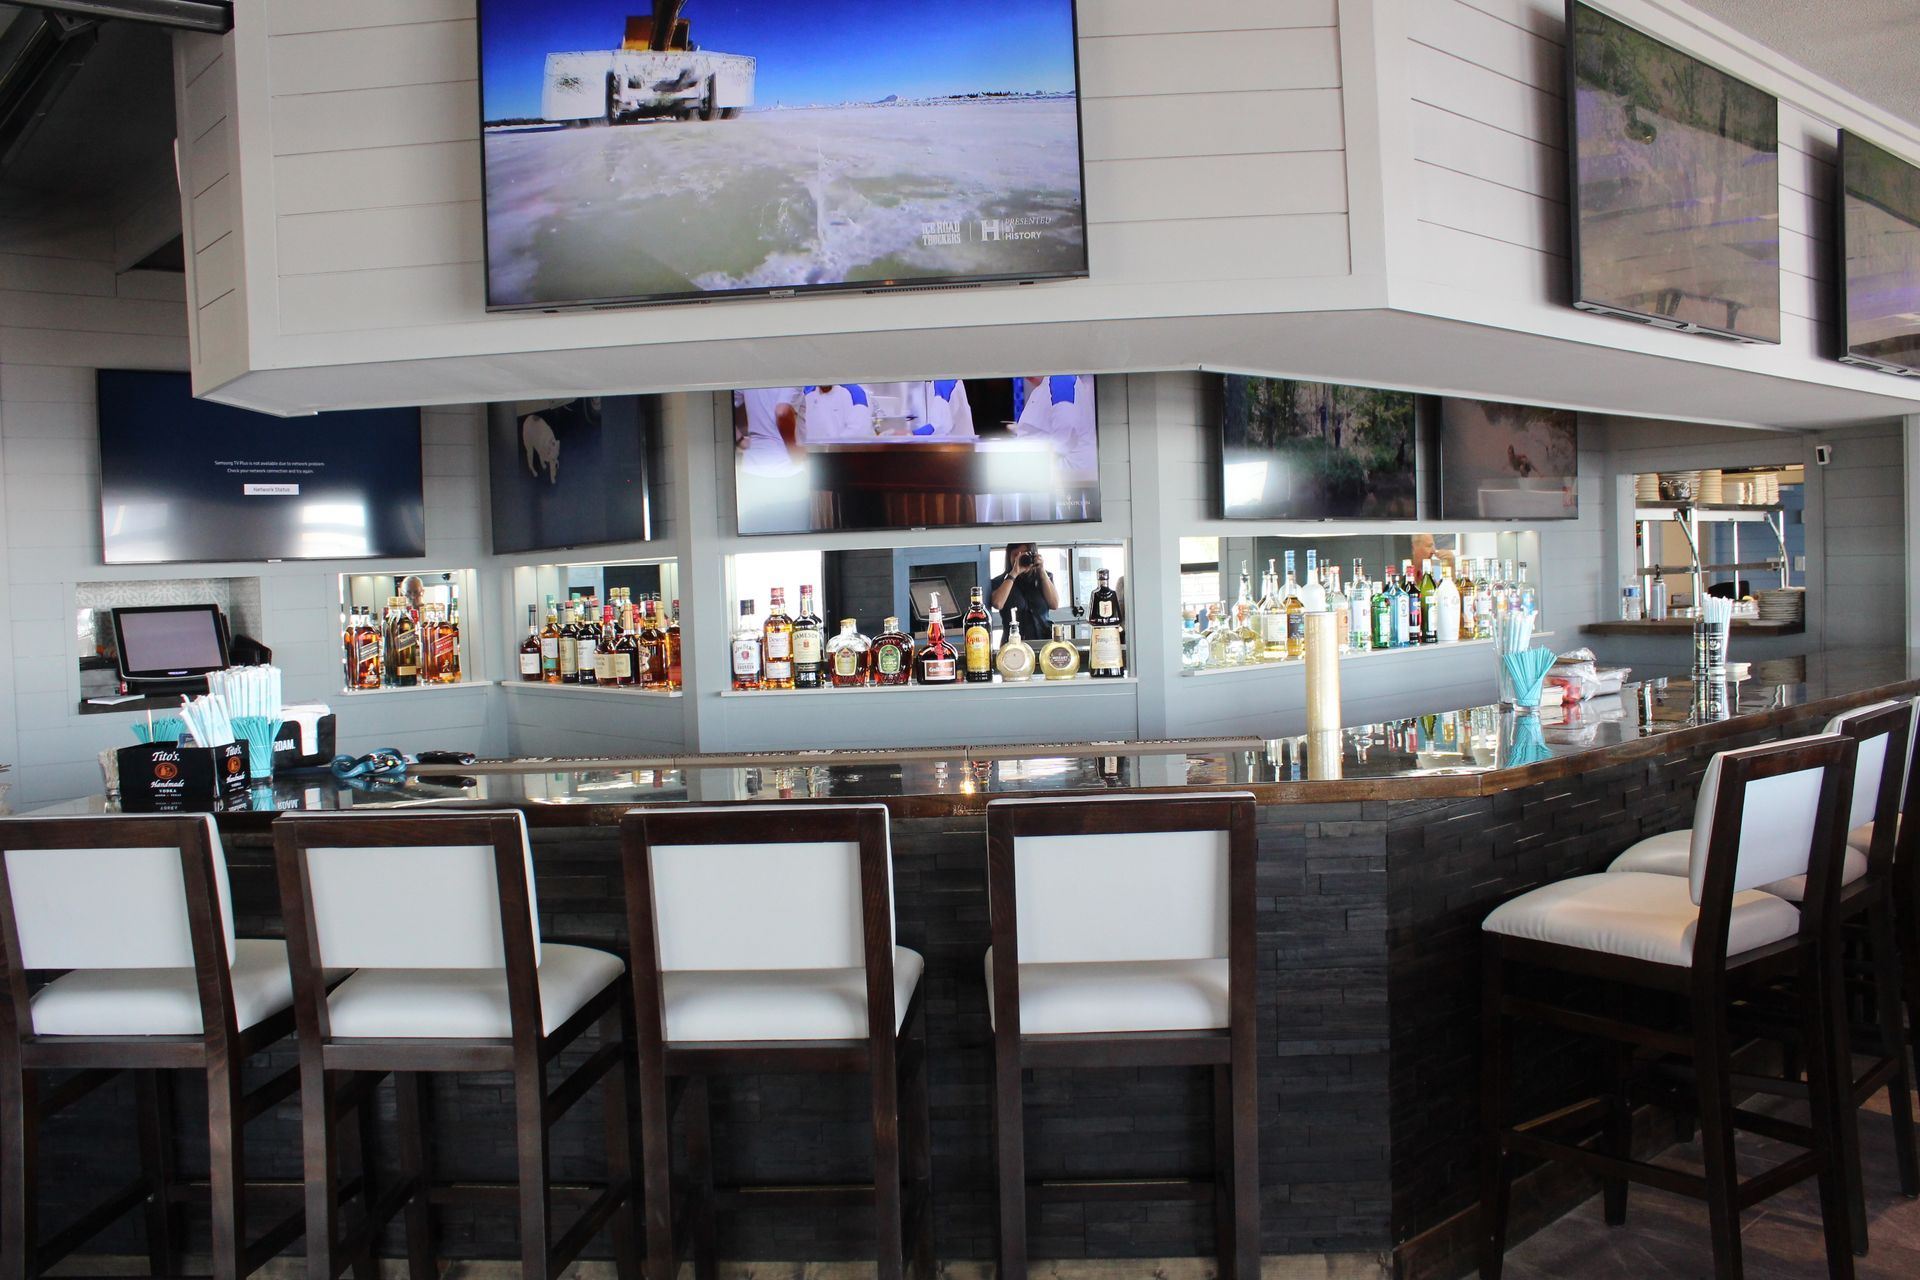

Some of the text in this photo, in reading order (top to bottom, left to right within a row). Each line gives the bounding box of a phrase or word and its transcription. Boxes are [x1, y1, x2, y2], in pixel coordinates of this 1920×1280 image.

[1005, 217, 1052, 226] PRESENTED
[937, 220, 960, 233] ROAD
[981, 219, 1000, 241] H
[922, 233, 961, 246] TRUCKERS
[1005, 231, 1042, 240] HISTORY
[793, 632, 818, 640] JAMESON
[150, 779, 185, 788] Handmade
